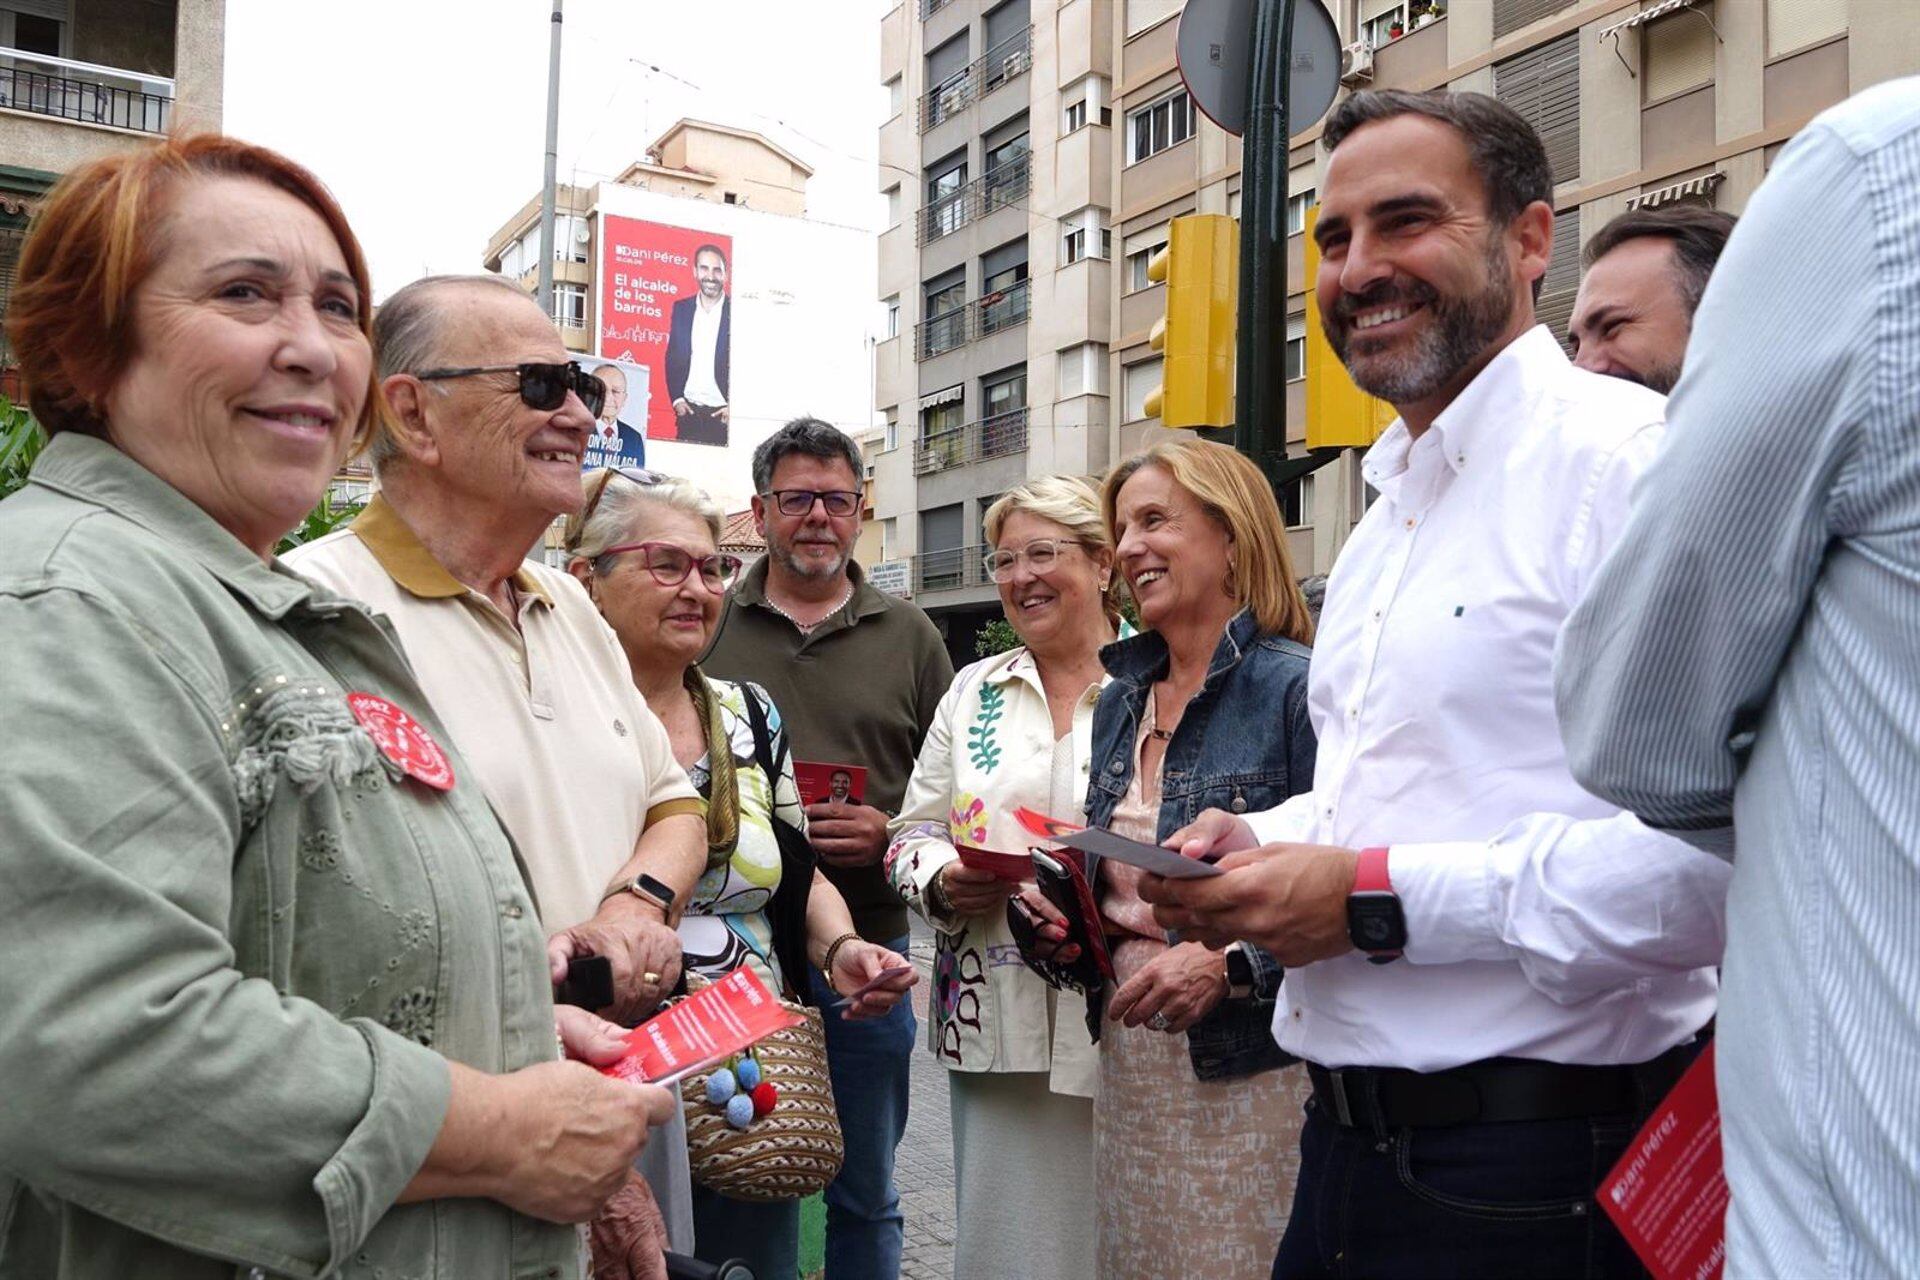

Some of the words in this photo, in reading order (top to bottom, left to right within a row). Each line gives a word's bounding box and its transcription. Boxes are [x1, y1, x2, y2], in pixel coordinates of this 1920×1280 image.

[620, 245, 651, 260] Dani
[653, 250, 688, 267] Pérez
[614, 273, 628, 286] El
[631, 277, 678, 294] alcalde
[614, 287, 631, 300] de
[635, 289, 654, 303] los
[614, 299, 662, 317] barrios
[587, 434, 600, 449] ON
[583, 451, 603, 466] ANA
[1616, 1154, 1647, 1194] Dani
[1695, 1238, 1726, 1280] alcald
